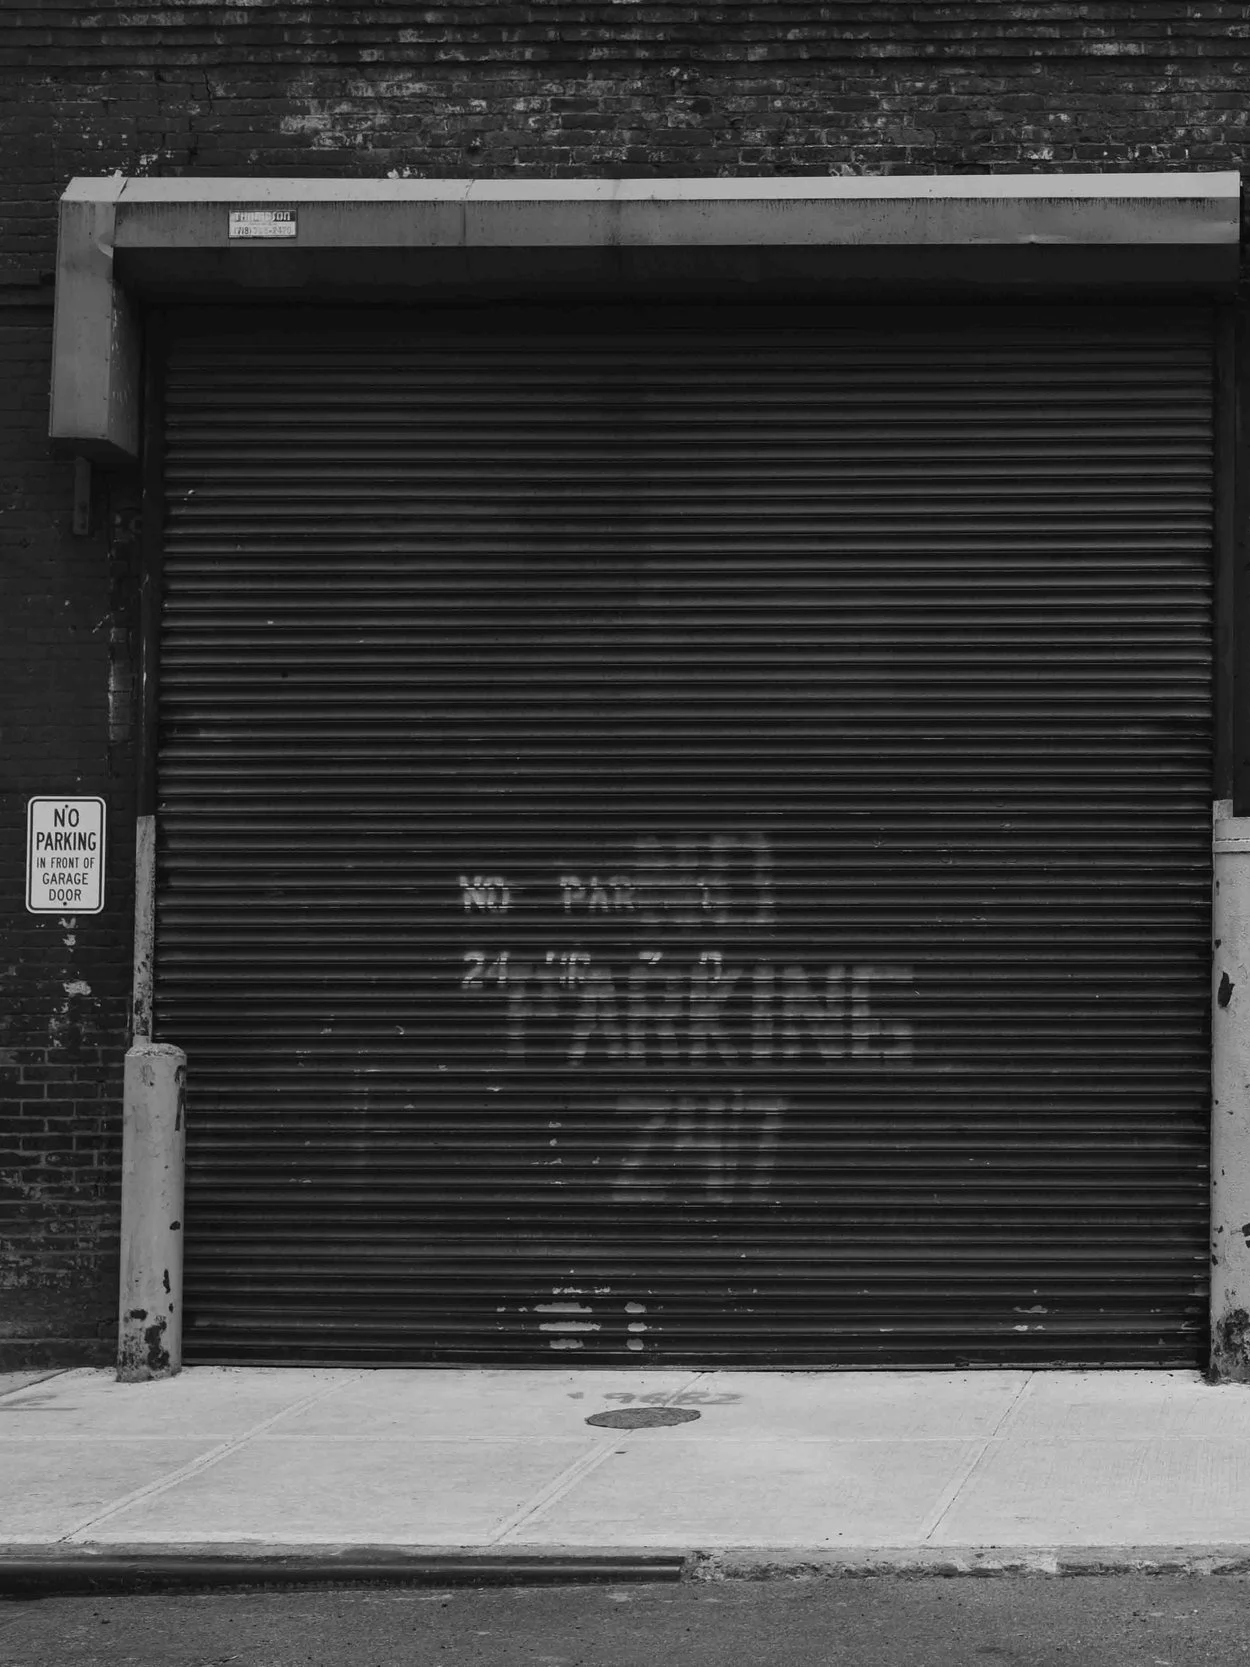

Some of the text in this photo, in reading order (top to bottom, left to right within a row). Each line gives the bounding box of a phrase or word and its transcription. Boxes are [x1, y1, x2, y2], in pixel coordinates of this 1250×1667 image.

[53, 808, 80, 827] NO
[36, 832, 97, 851] PARKING
[36, 857, 95, 869] IN FRONT OF
[42, 872, 89, 885] GARAGE
[49, 889, 82, 901] DOOR
[459, 876, 510, 912] NO
[461, 951, 509, 987] 24
